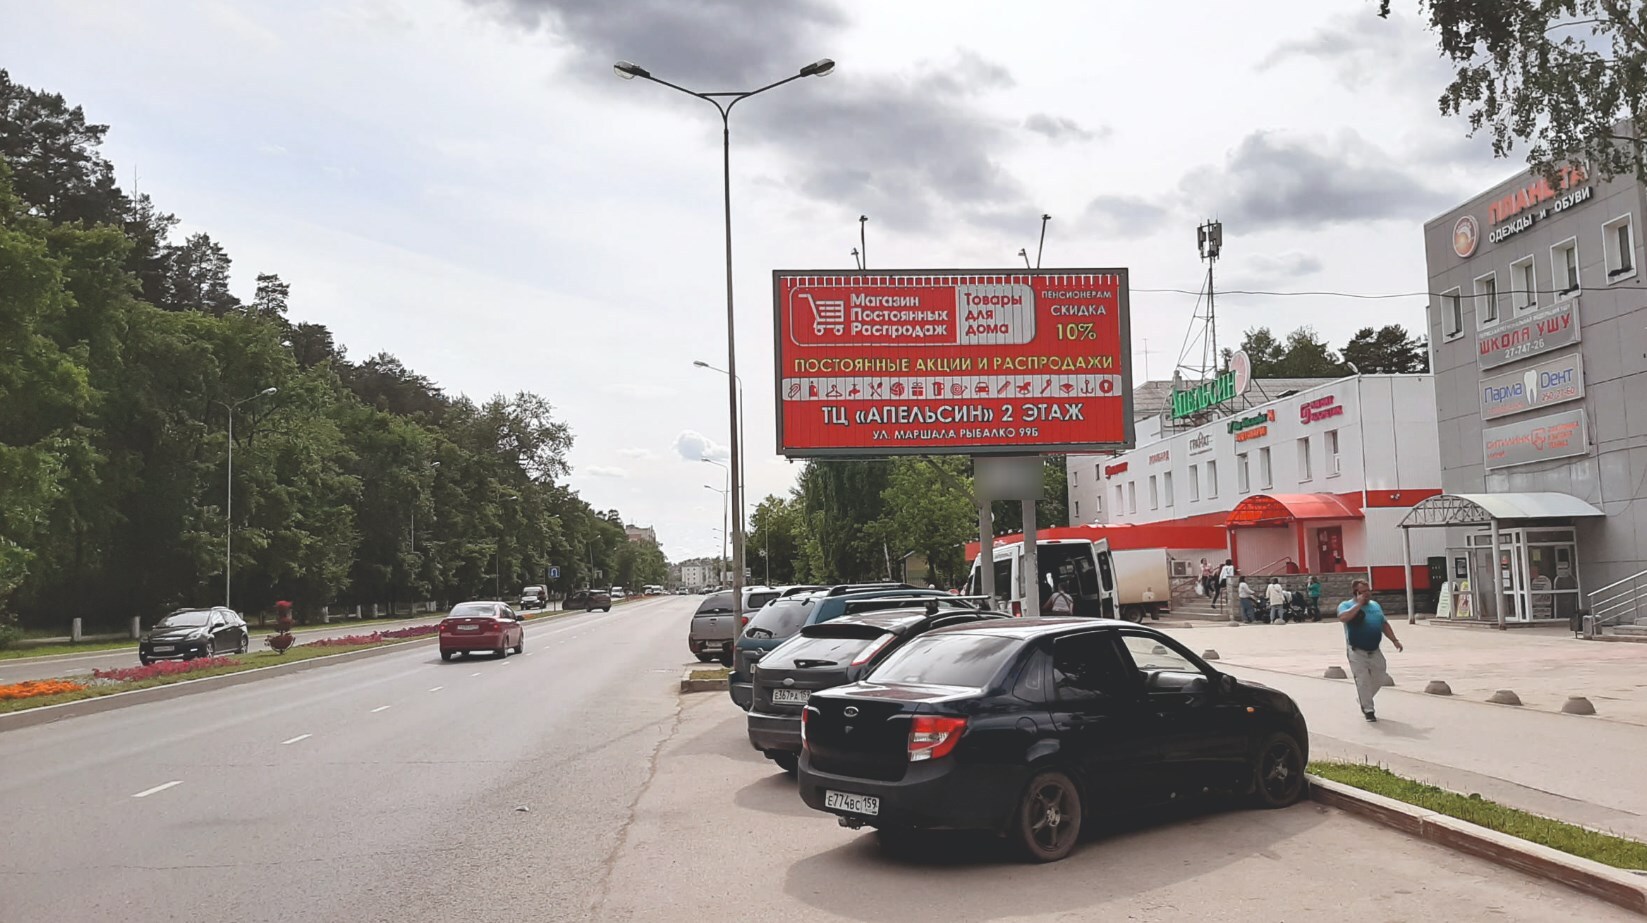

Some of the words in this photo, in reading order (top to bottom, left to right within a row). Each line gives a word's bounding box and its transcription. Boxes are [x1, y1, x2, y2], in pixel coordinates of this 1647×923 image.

[1488, 213, 1533, 243] ОДЕЖДЫ
[1554, 185, 1591, 213] ОБУВИ
[850, 293, 919, 307] Магазин
[964, 292, 1023, 308] Товары
[1041, 290, 1112, 299] ПЕНСИОНЕРАМ
[850, 308, 949, 321] Постоянных
[965, 310, 994, 322] для
[1050, 304, 1107, 317] СКИДКА
[850, 323, 948, 338] Распродаж
[965, 322, 1009, 336] дома
[1056, 322, 1097, 341] 10%
[1480, 326, 1530, 356] ШКОЛА
[1536, 312, 1571, 337] УШУ
[794, 358, 910, 373] ПОСТОЯННЫЕ
[915, 356, 972, 372] АКЦИИ
[978, 357, 988, 370] И
[993, 355, 1113, 371] РАСПРОДАЖИ
[1484, 382, 1523, 403] Парма
[822, 406, 849, 426] ТЦ
[855, 403, 994, 425] «АПЕЛЬСИН»
[1001, 404, 1014, 422] 2
[1022, 402, 1084, 422] ЭТАЖ
[872, 430, 890, 441] УЛ.
[894, 429, 957, 440] МАРШАЛА
[960, 427, 1016, 438] РЫБАЛКО
[1019, 427, 1039, 438] 99Б
[827, 792, 861, 811] Е774ВС
[863, 797, 877, 809] 159
